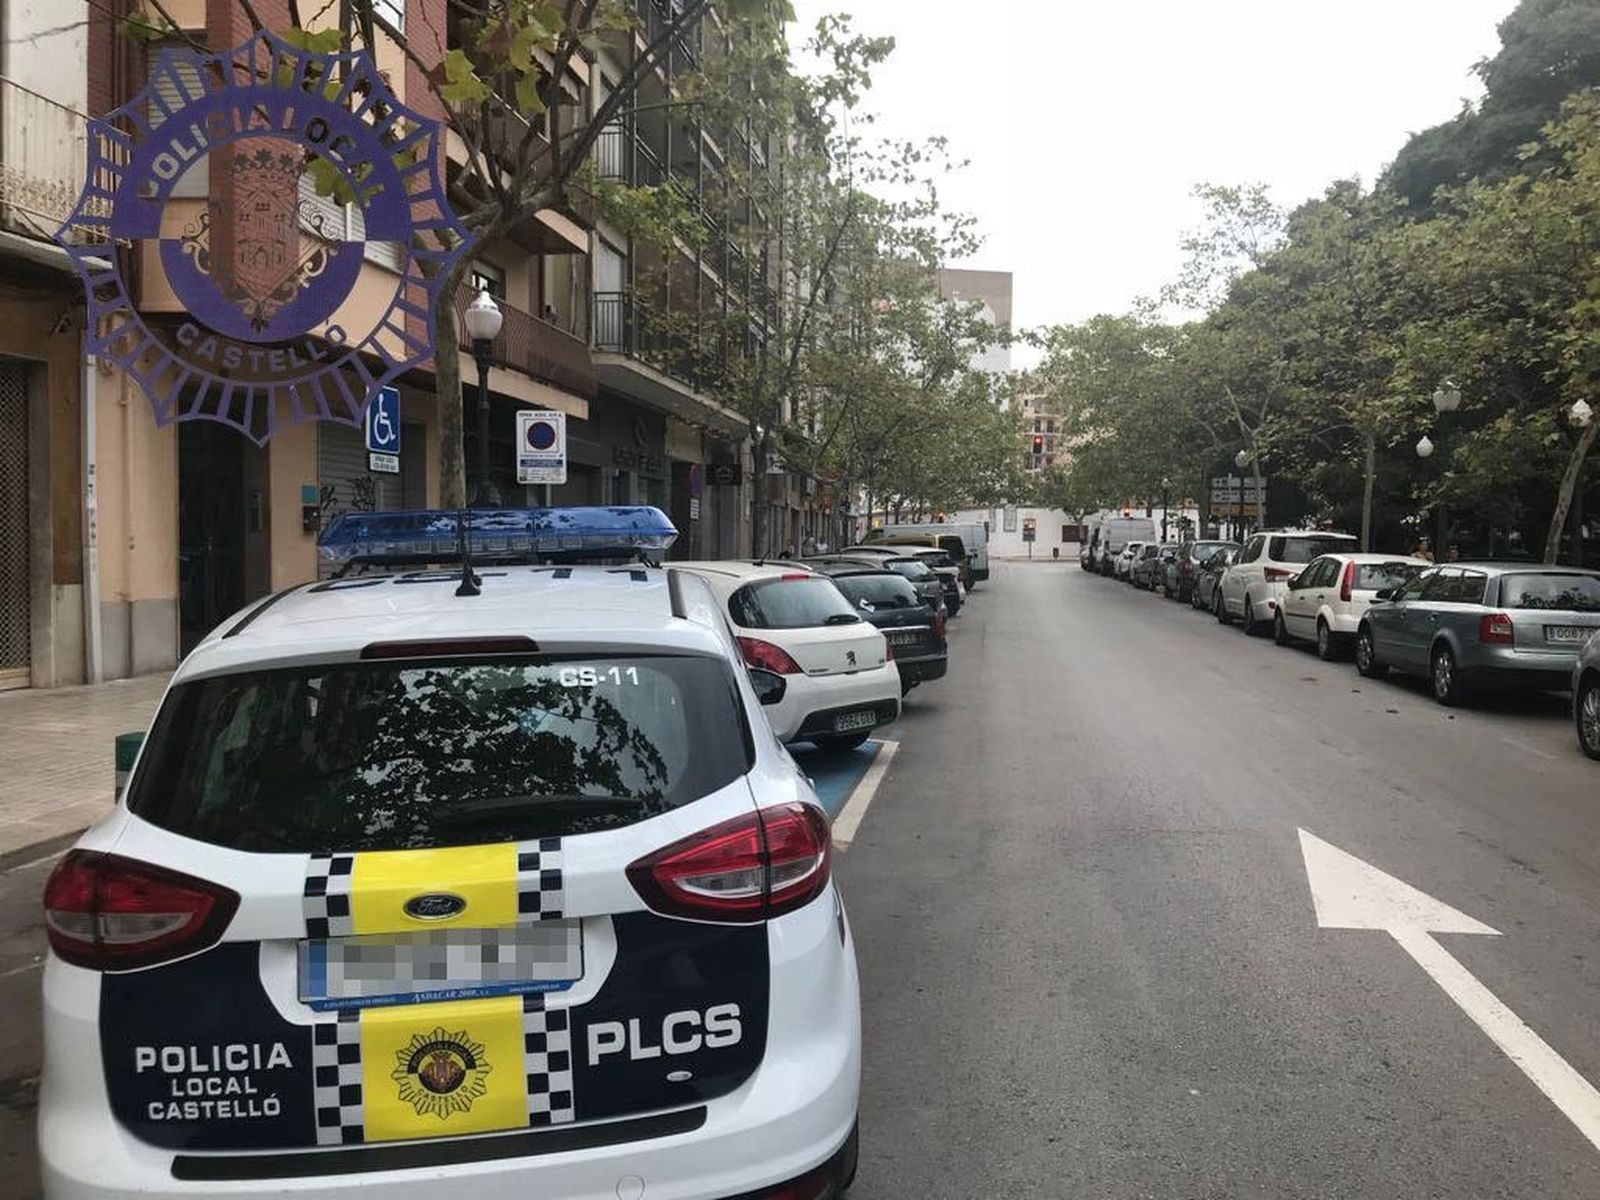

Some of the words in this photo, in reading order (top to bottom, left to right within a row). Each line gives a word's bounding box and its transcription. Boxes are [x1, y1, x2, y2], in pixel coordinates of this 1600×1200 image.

[560, 666, 639, 687] CS-11
[587, 1002, 742, 1067] PLCS
[135, 1042, 293, 1073] POLICIA
[172, 1076, 258, 1096] LOCAL
[149, 1093, 281, 1120] CASTELLÓ
